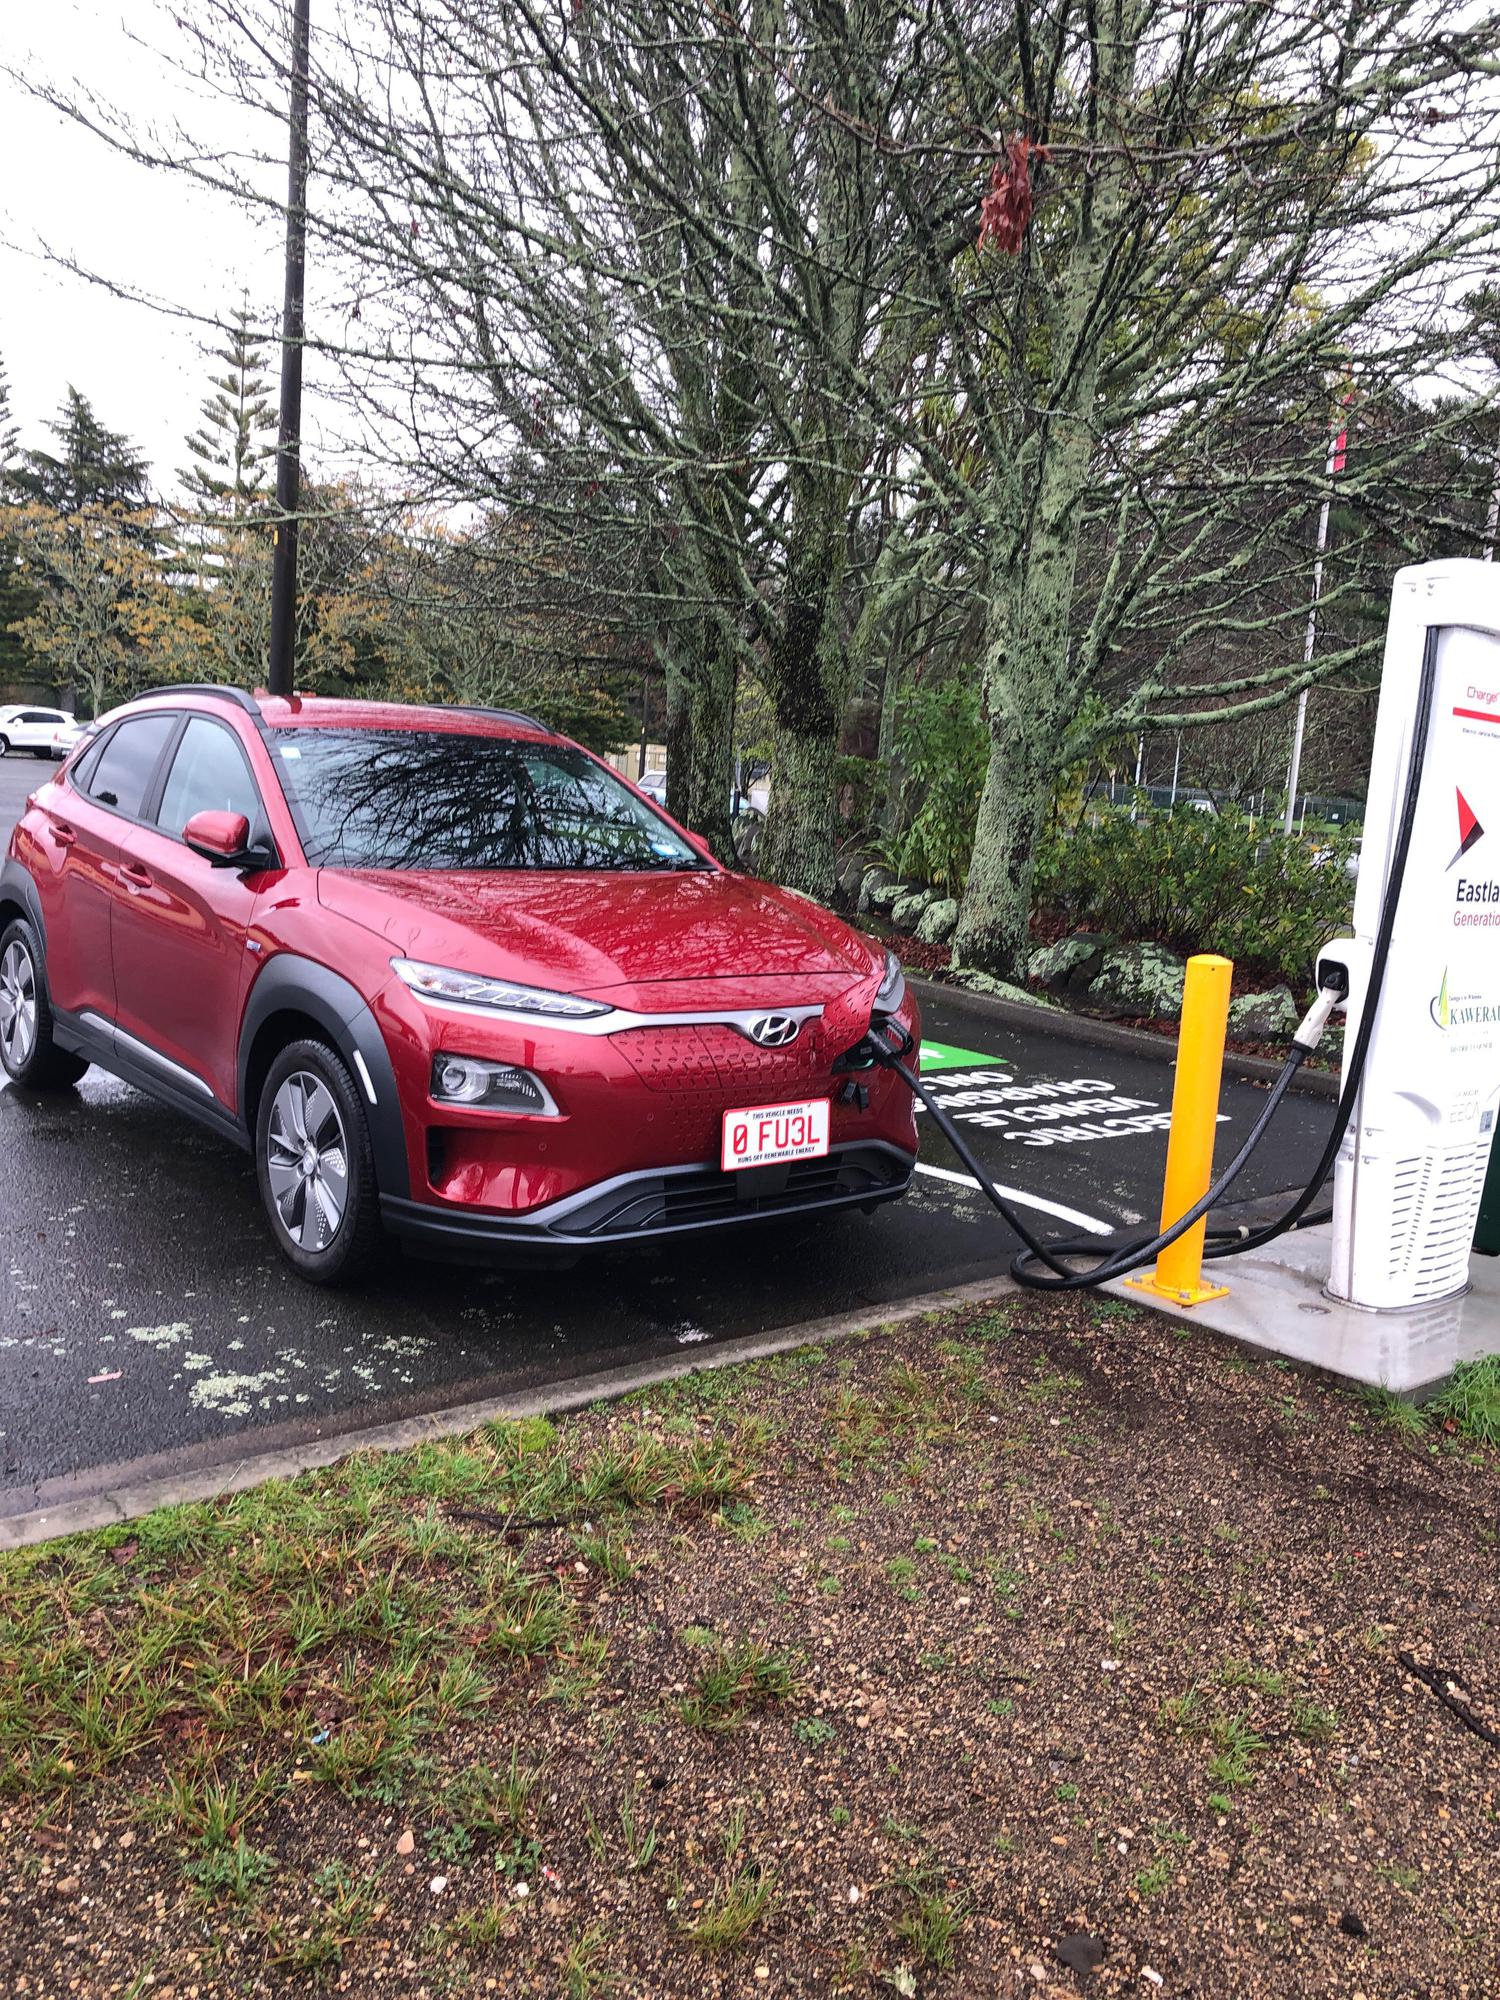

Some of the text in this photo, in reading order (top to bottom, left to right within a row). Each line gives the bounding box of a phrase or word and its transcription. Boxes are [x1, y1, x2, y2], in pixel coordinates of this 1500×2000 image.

[1466, 686, 1500, 705] Charge
[1456, 878, 1500, 903] Eastla
[919, 1071, 1014, 1090] ONL
[752, 1107, 804, 1120] THIS VEHICLE NEEDS
[952, 1095, 1161, 1128] VEHICLE
[733, 1115, 820, 1155] 0 FU3L
[737, 1146, 815, 1164] RUNS OFF RENEWABLE ENERGY
